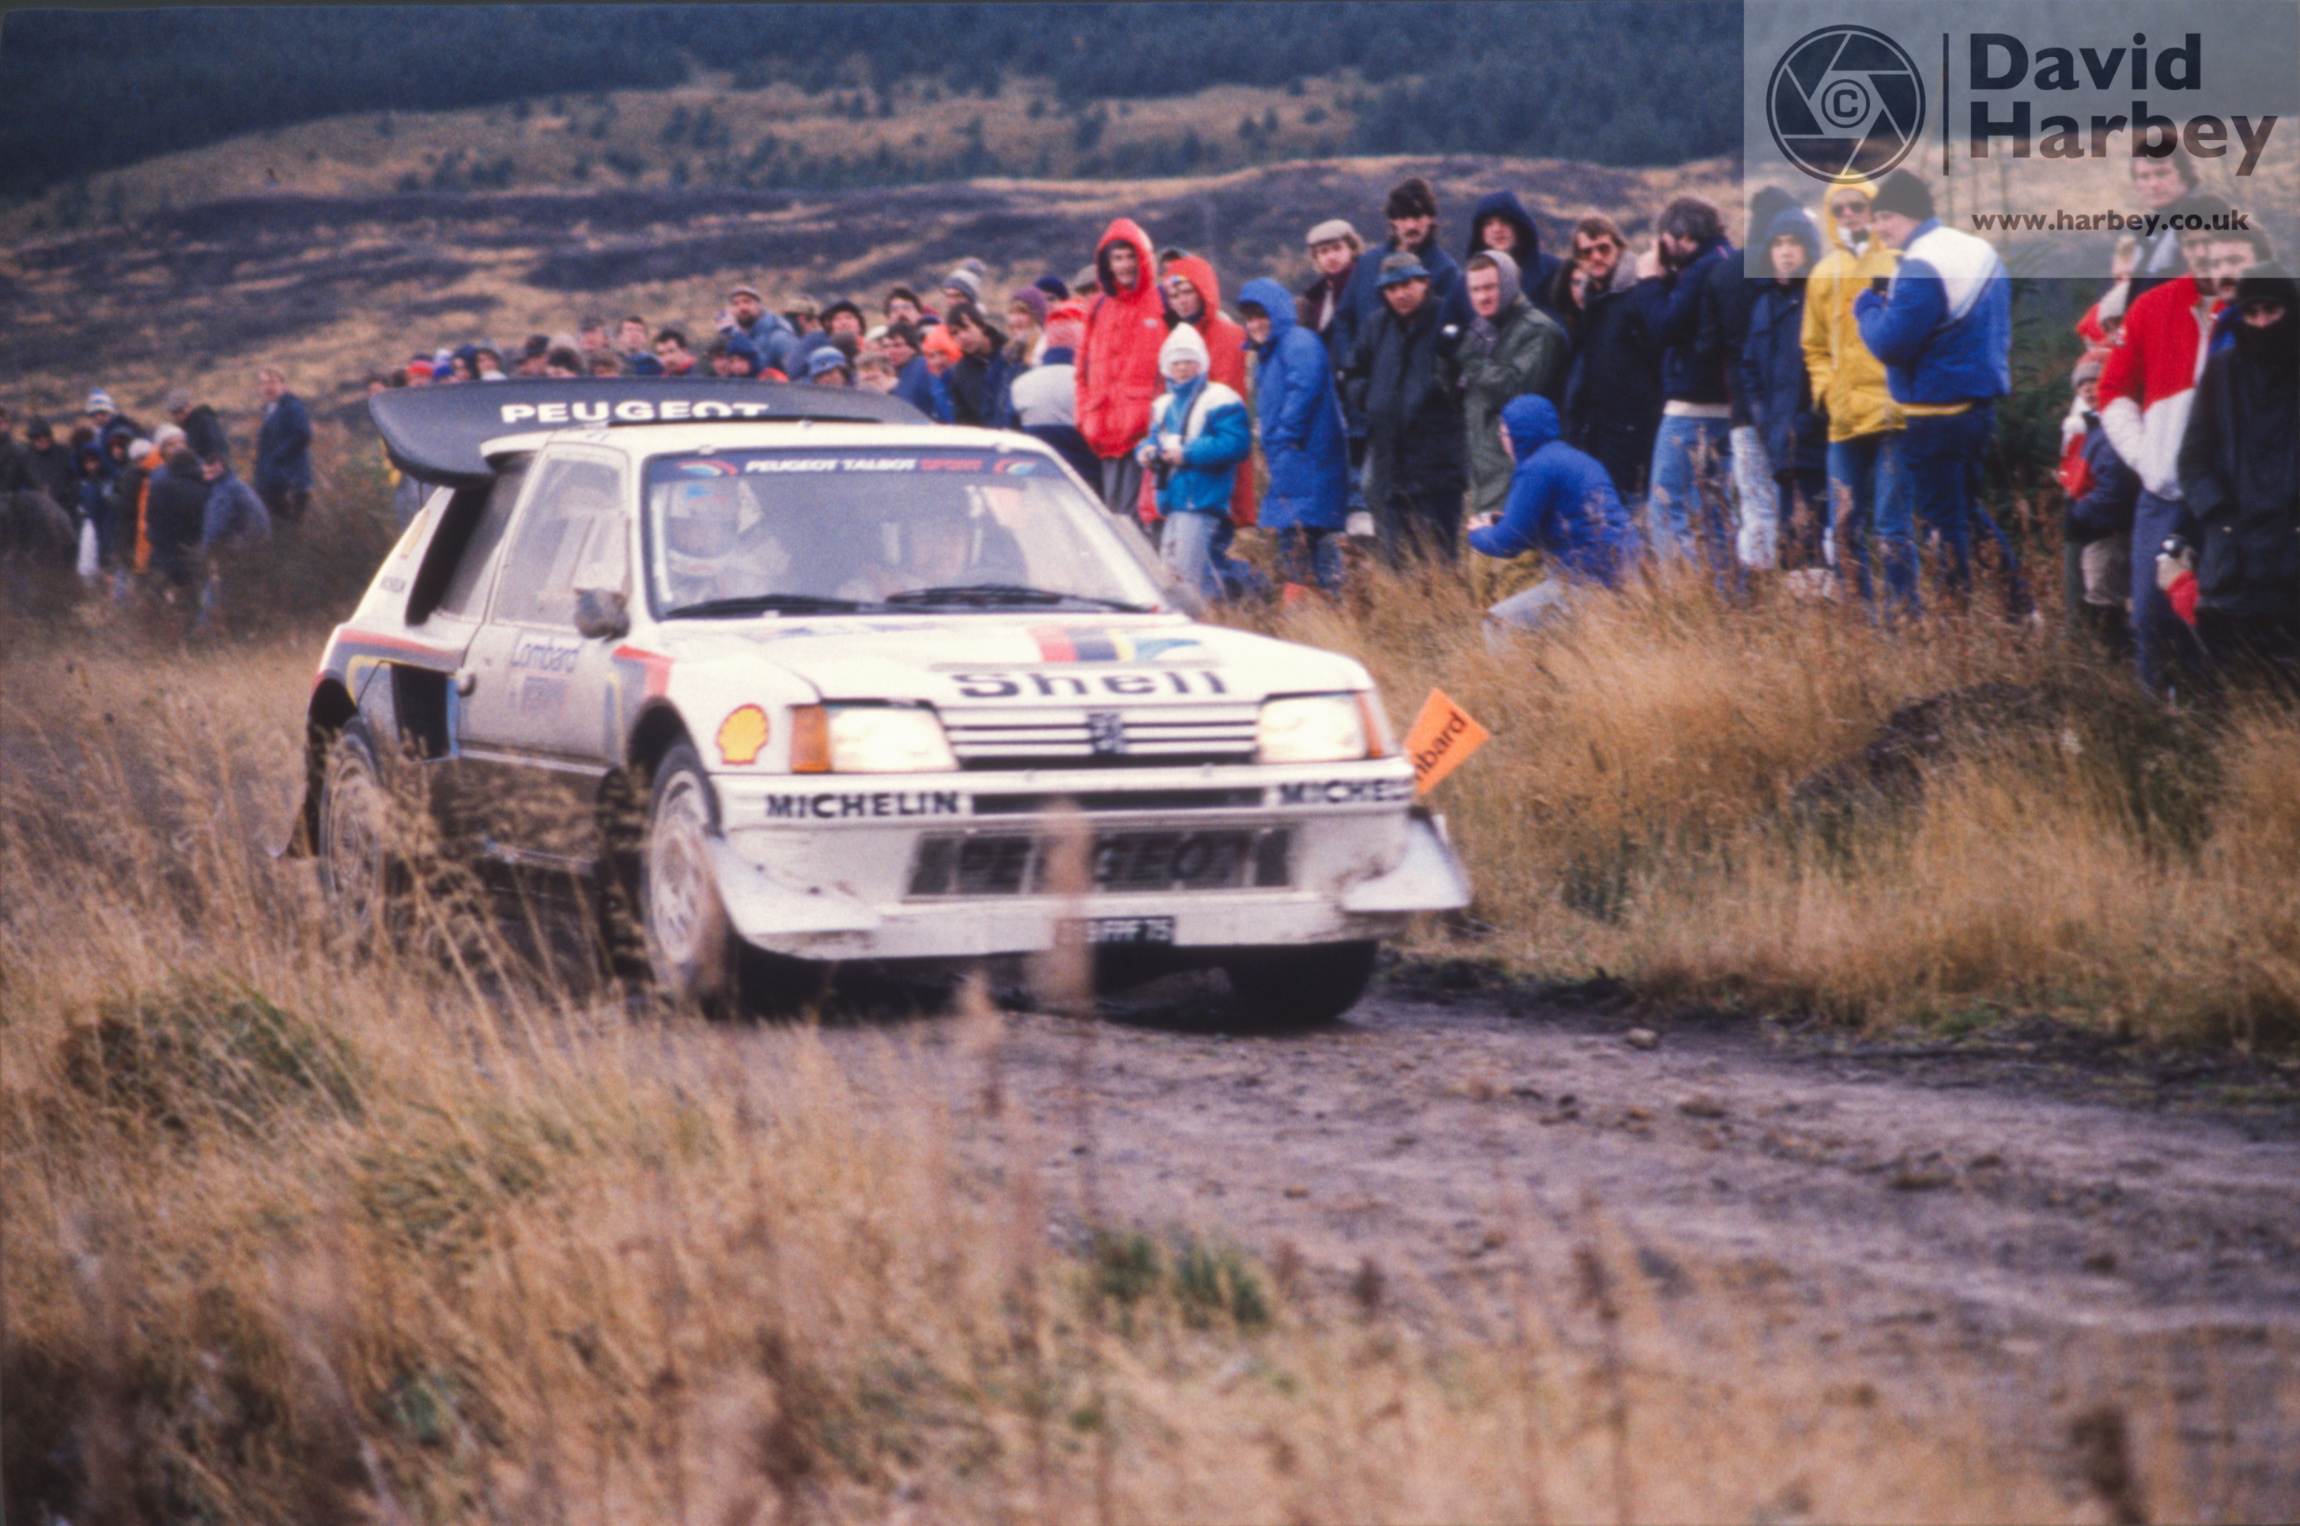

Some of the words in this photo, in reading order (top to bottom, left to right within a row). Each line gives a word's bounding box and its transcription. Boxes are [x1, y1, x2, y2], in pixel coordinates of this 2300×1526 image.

[500, 400, 769, 424] PEUGEOT
[745, 458, 839, 473] PEUGEOT
[843, 458, 917, 472] TALBOT
[951, 671, 1229, 698] Shell
[766, 791, 959, 818] MICHELIN
